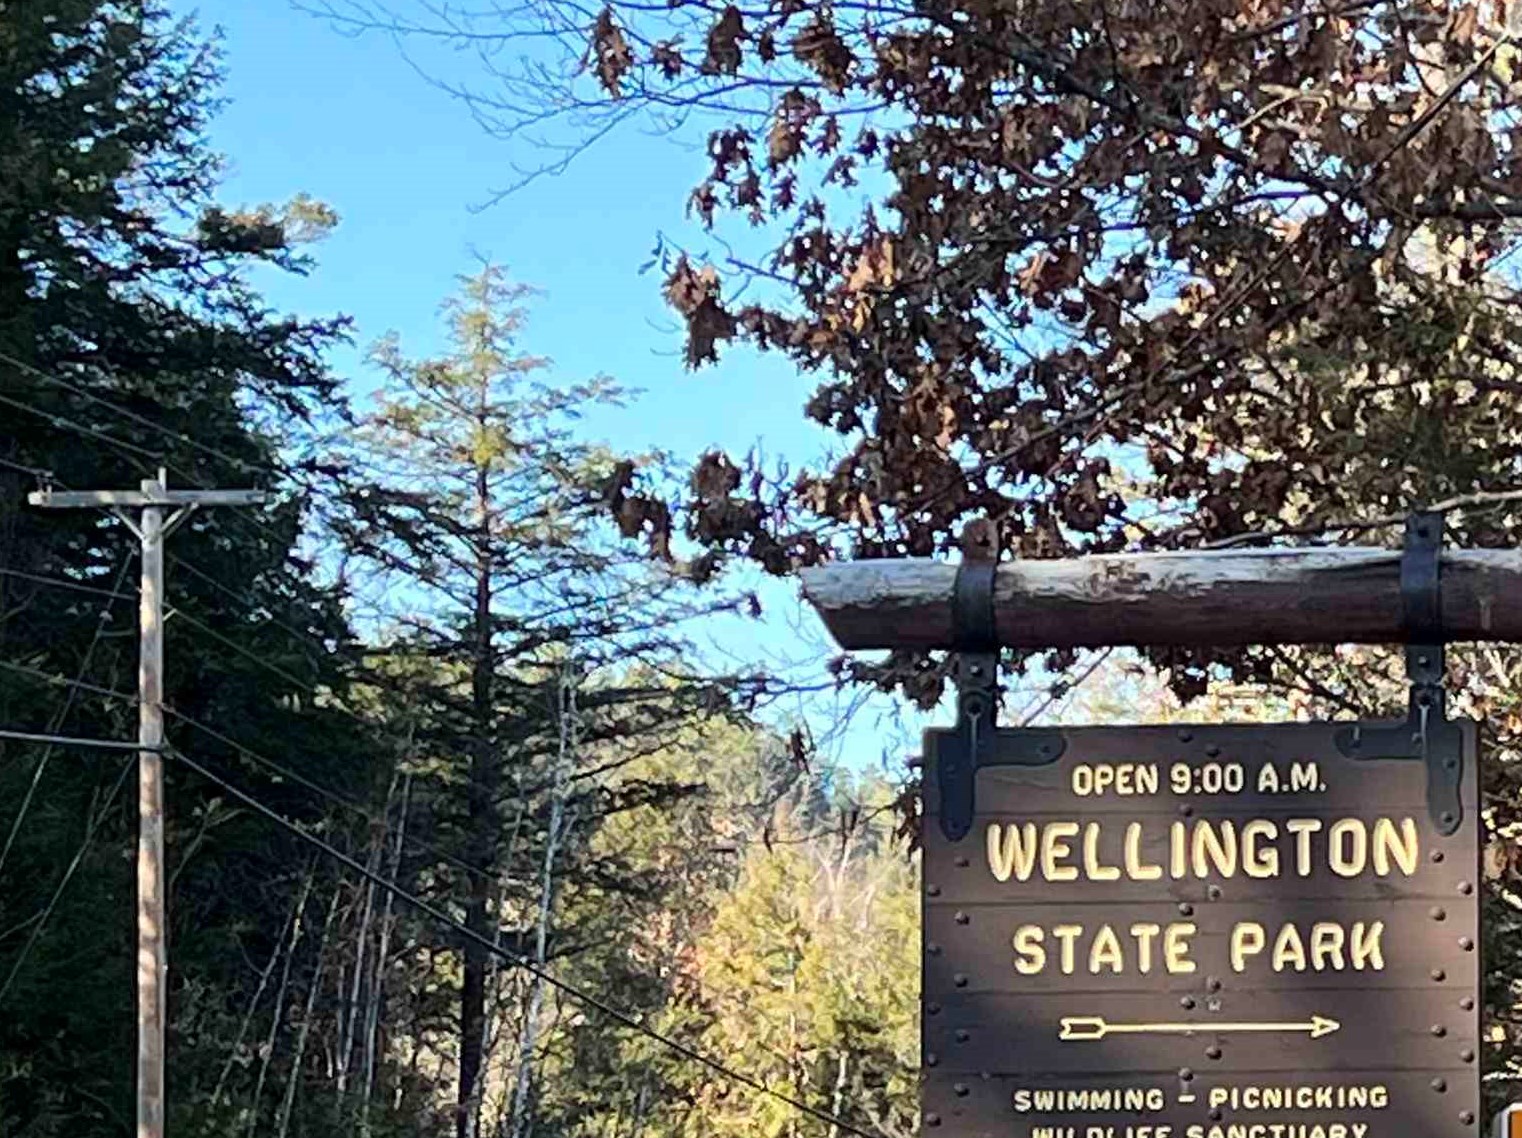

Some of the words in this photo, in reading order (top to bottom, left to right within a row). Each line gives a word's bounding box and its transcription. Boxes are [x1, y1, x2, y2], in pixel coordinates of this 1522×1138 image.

[1072, 763, 1158, 796] OPEN
[1170, 763, 1244, 795] 9:00
[1258, 761, 1327, 793] A.M.
[986, 817, 1420, 882] WELLINGTON
[1012, 922, 1197, 975] STATE
[1230, 920, 1386, 973] PARK
[1013, 1088, 1165, 1113] SWIMMING
[1209, 1085, 1389, 1111] PICNICKING
